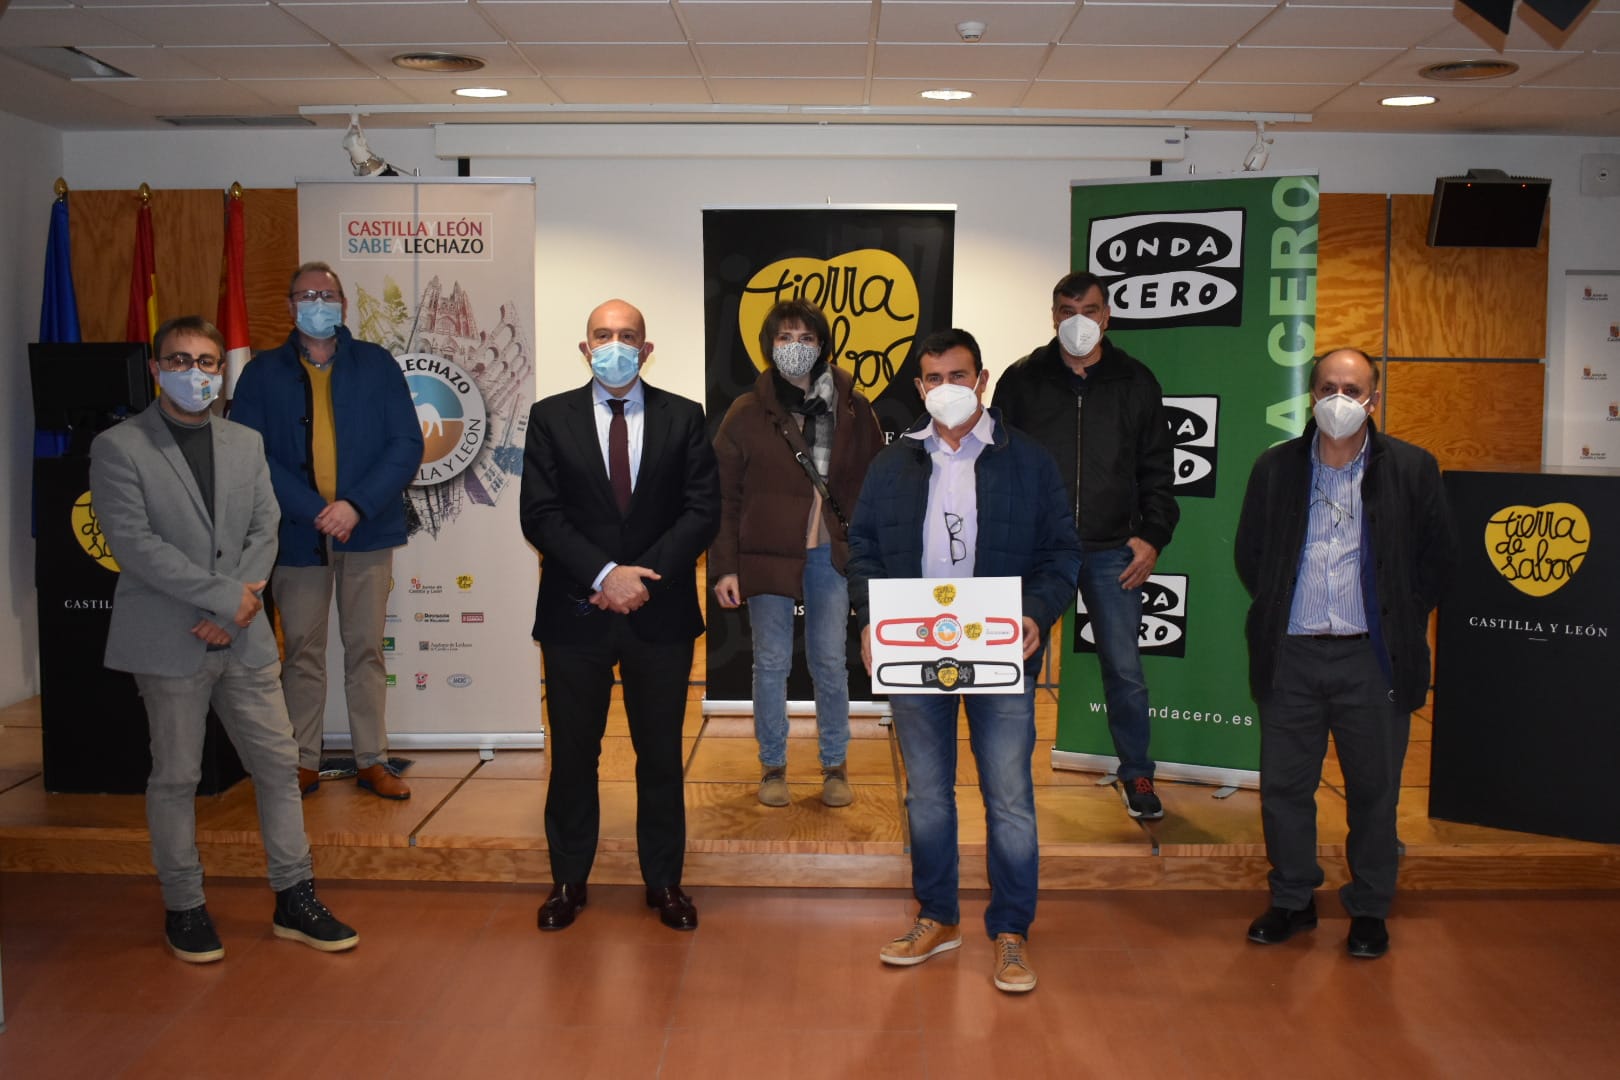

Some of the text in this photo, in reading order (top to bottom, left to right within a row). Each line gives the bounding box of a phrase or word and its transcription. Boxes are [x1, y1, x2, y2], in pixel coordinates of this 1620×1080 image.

[348, 221, 427, 237] CASTILLA
[437, 218, 483, 237] LEÓN
[348, 239, 392, 254] SABE
[404, 239, 484, 254] LECHAZO
[1108, 235, 1218, 263] ONDA
[1267, 177, 1319, 366] CERO
[745, 266, 914, 322] tierra
[1113, 281, 1218, 310] CERO
[830, 315, 917, 388] bor
[443, 418, 481, 472] Y LEÓN
[1488, 510, 1587, 544] tierra
[1495, 537, 1526, 555] de
[1501, 539, 1587, 583] sabor
[64, 599, 113, 609] CASTIL
[1138, 623, 1169, 641] RO
[1469, 616, 1608, 638] CASTILLA Y LEÓN
